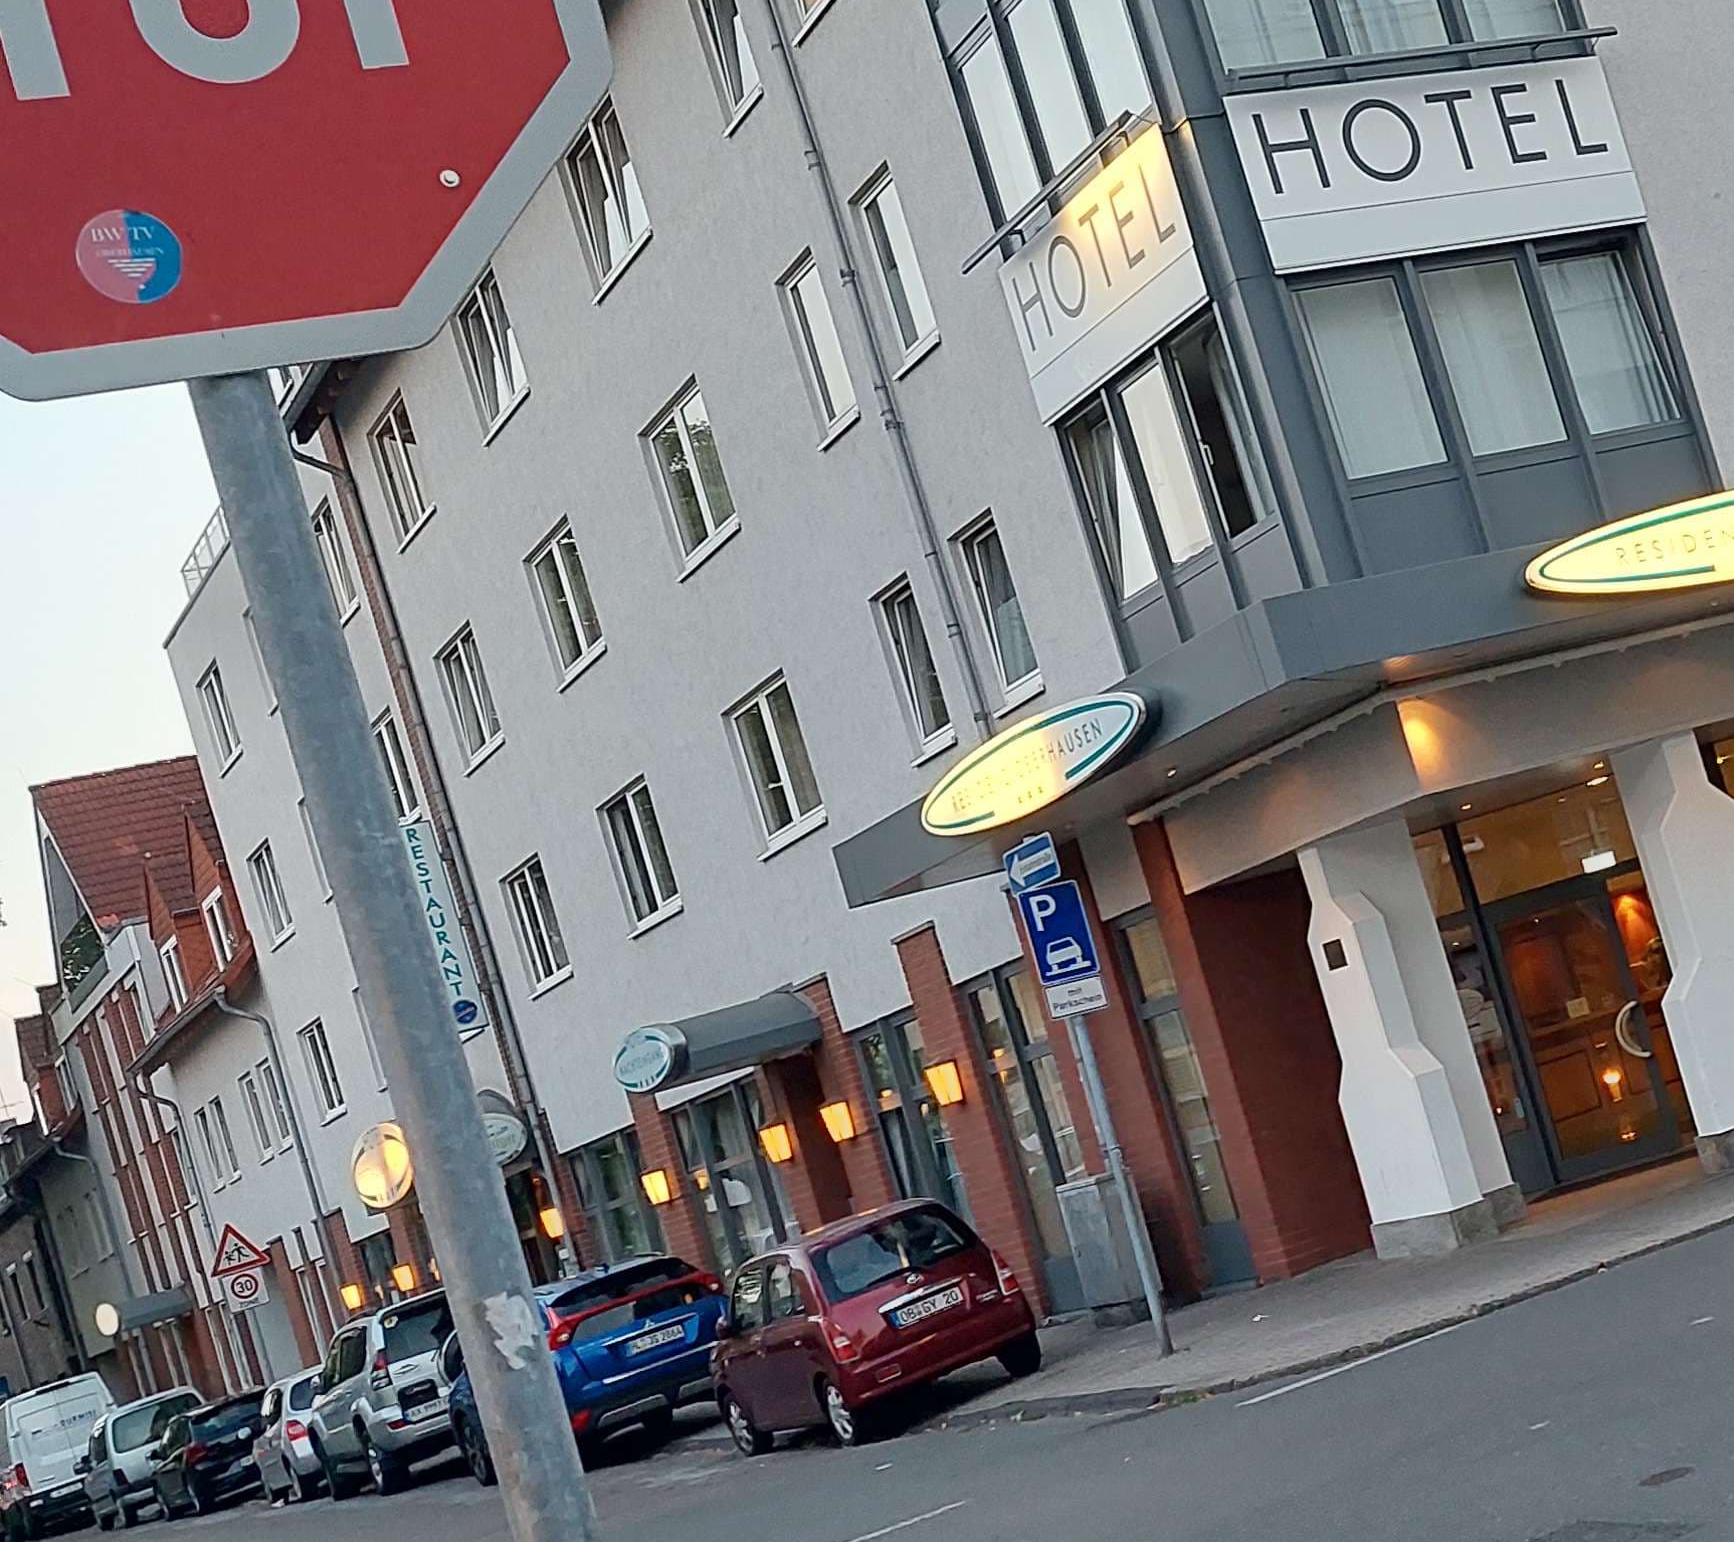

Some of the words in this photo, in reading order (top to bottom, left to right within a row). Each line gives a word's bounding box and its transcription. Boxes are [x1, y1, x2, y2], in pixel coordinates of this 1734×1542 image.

[1250, 77, 1609, 196] HOTEL
[1010, 161, 1177, 353] HOTEL
[405, 828, 463, 997] RESTAURANT
[1028, 893, 1057, 933] P
[235, 1278, 254, 1294] 30
